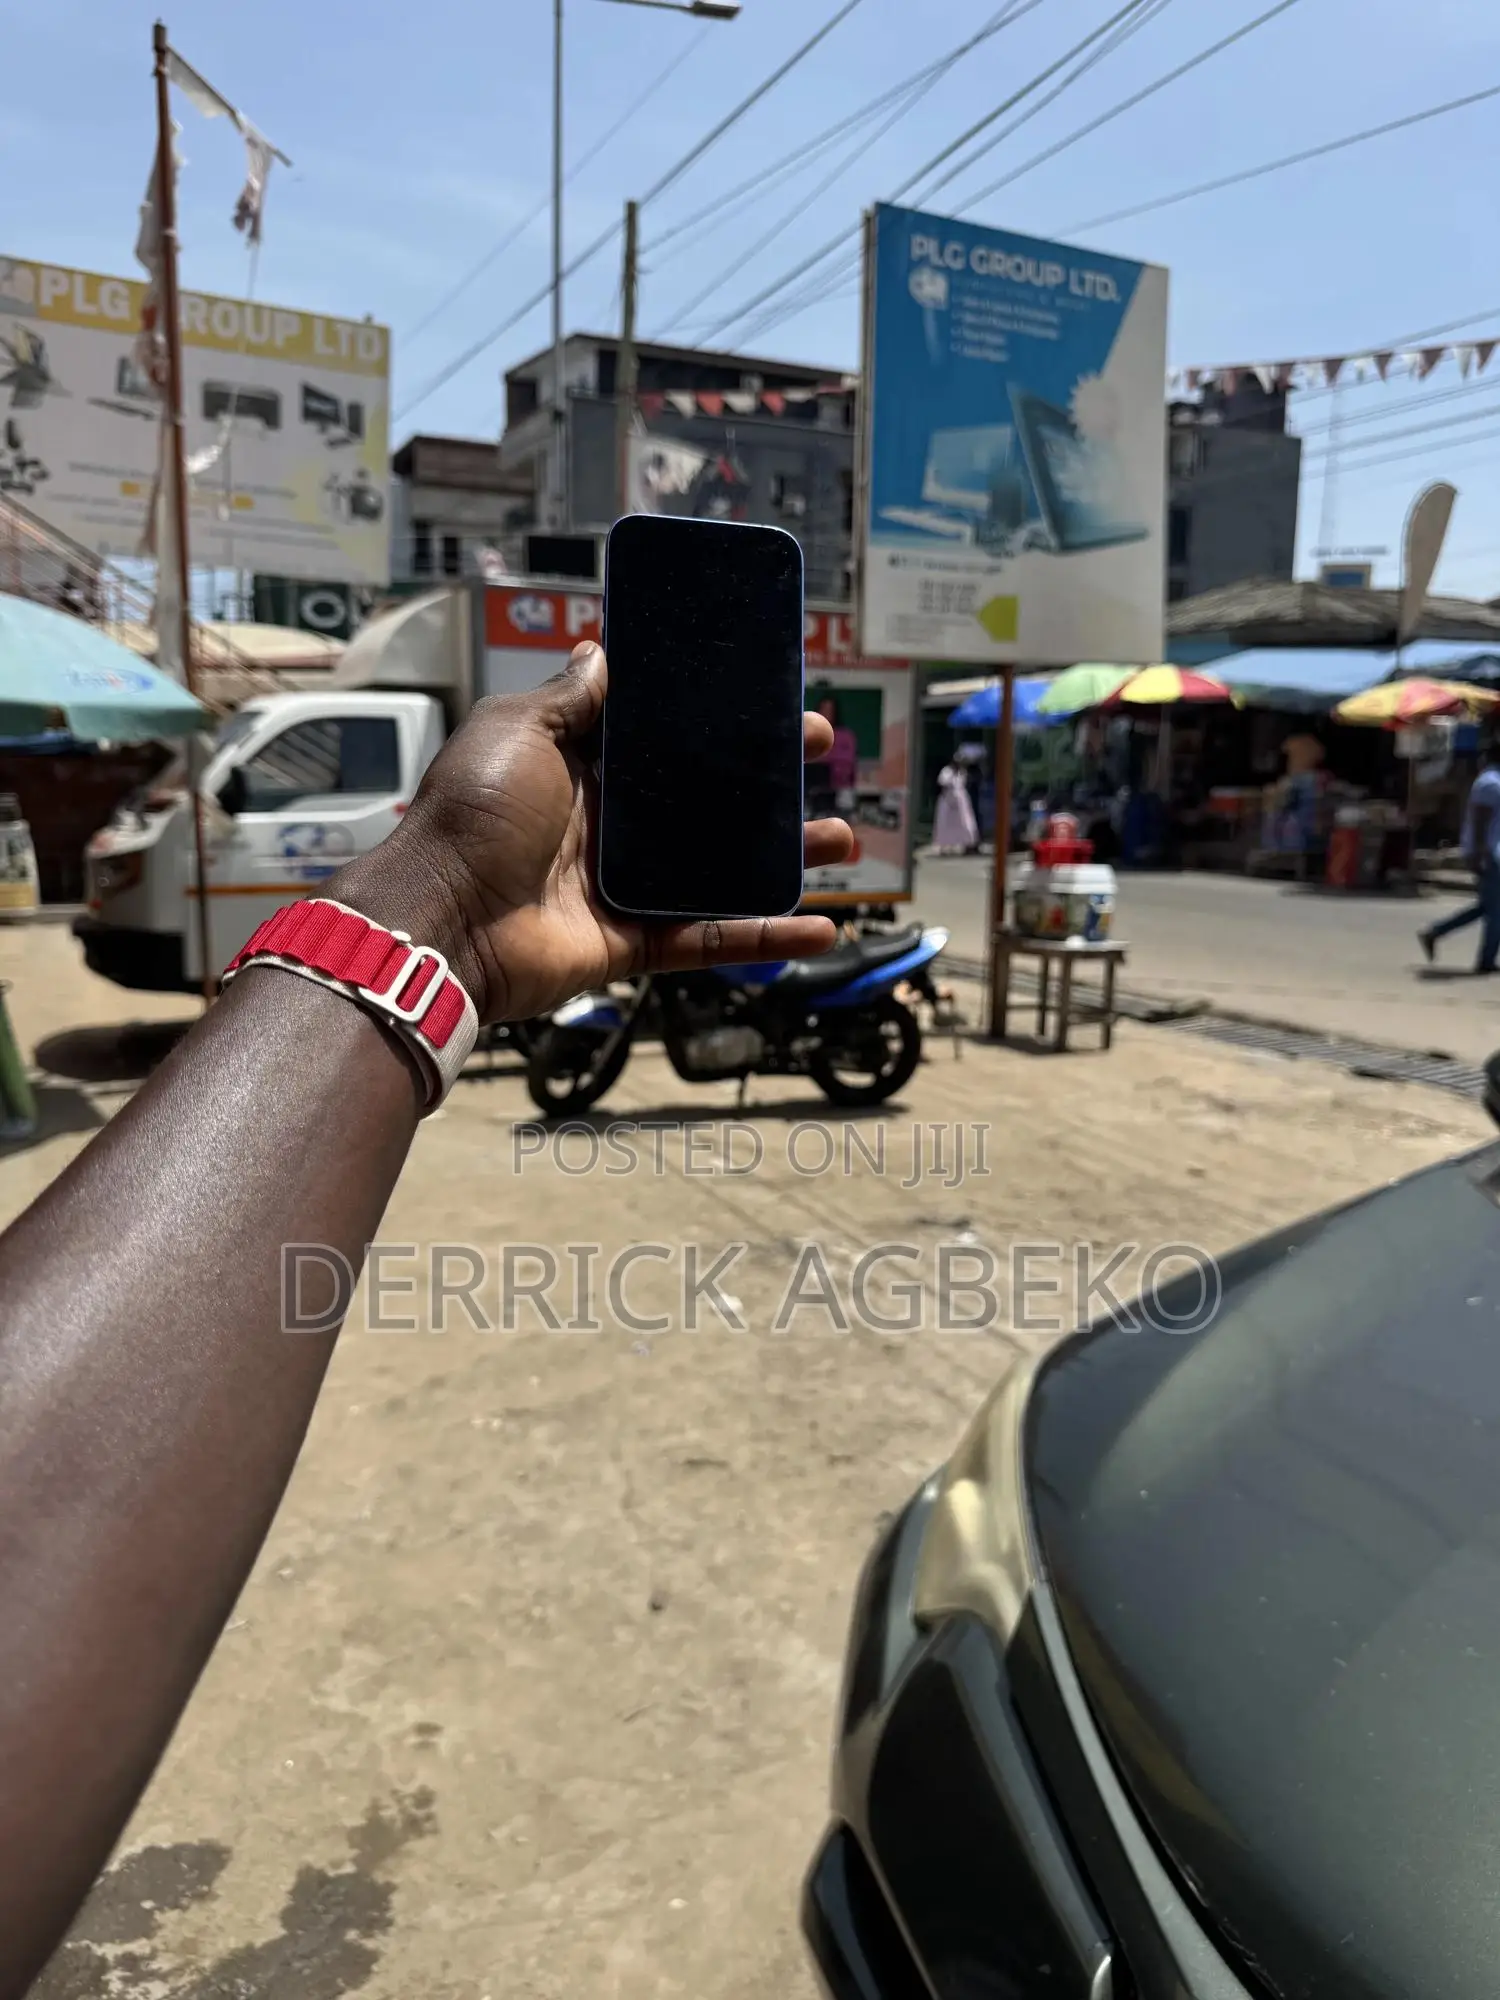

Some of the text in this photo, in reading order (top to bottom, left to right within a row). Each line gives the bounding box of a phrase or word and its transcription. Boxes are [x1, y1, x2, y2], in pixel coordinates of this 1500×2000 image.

[911, 234, 967, 271] PLG
[969, 245, 1065, 288] GROUP
[39, 267, 382, 363] PLG ROUP LTD
